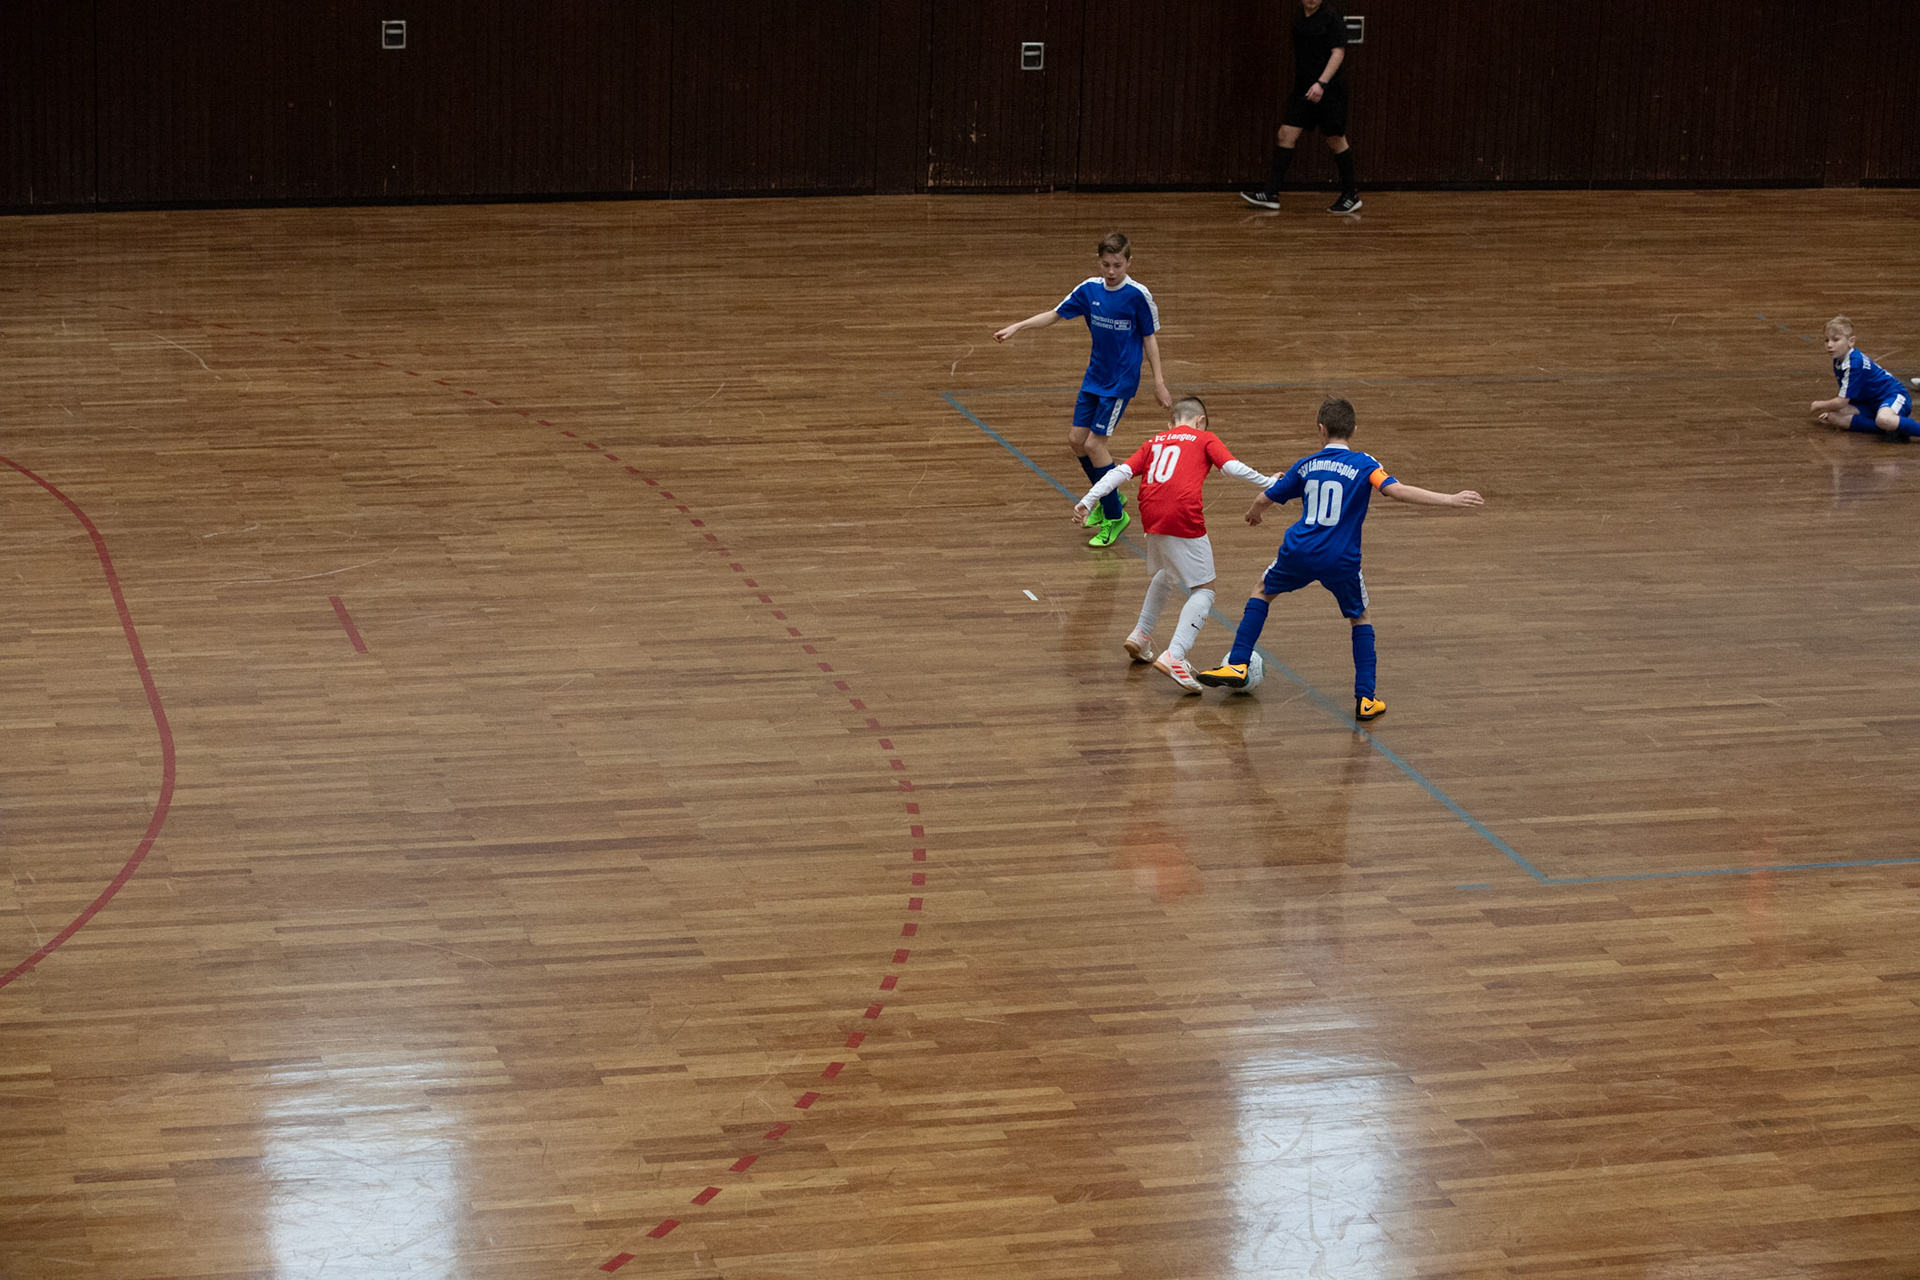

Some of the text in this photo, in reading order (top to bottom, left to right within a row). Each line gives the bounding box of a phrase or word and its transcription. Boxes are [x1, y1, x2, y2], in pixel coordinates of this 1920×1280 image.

[1147, 444, 1181, 484] 10
[1309, 458, 1359, 480] Lämmerspiel
[1304, 479, 1343, 526] 10
